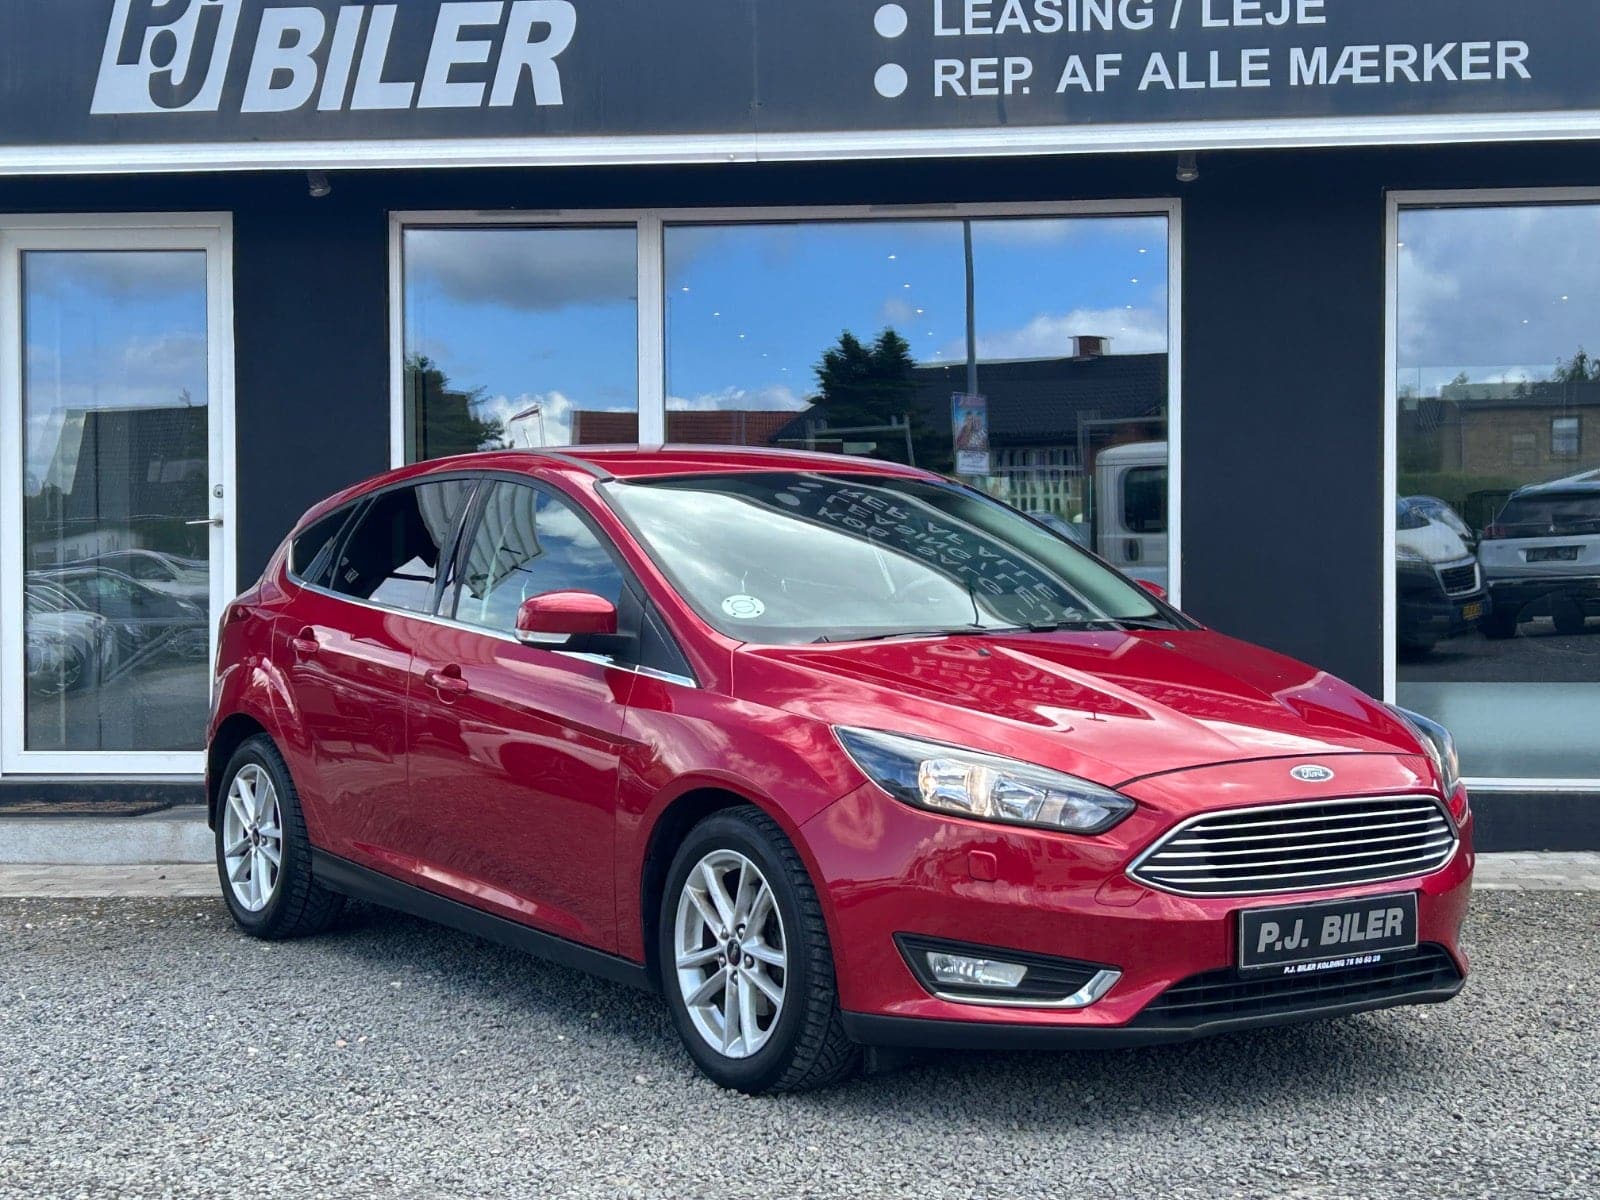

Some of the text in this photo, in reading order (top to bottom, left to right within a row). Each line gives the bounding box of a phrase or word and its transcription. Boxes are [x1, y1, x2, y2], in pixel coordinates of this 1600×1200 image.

[934, 0, 1154, 37] LEASING
[1201, 0, 1327, 28] LEJE
[240, 0, 576, 113] BILER
[935, 41, 1532, 97] REP. AF ALLE MÆRKER
[1257, 907, 1404, 953] P.J. BILER
